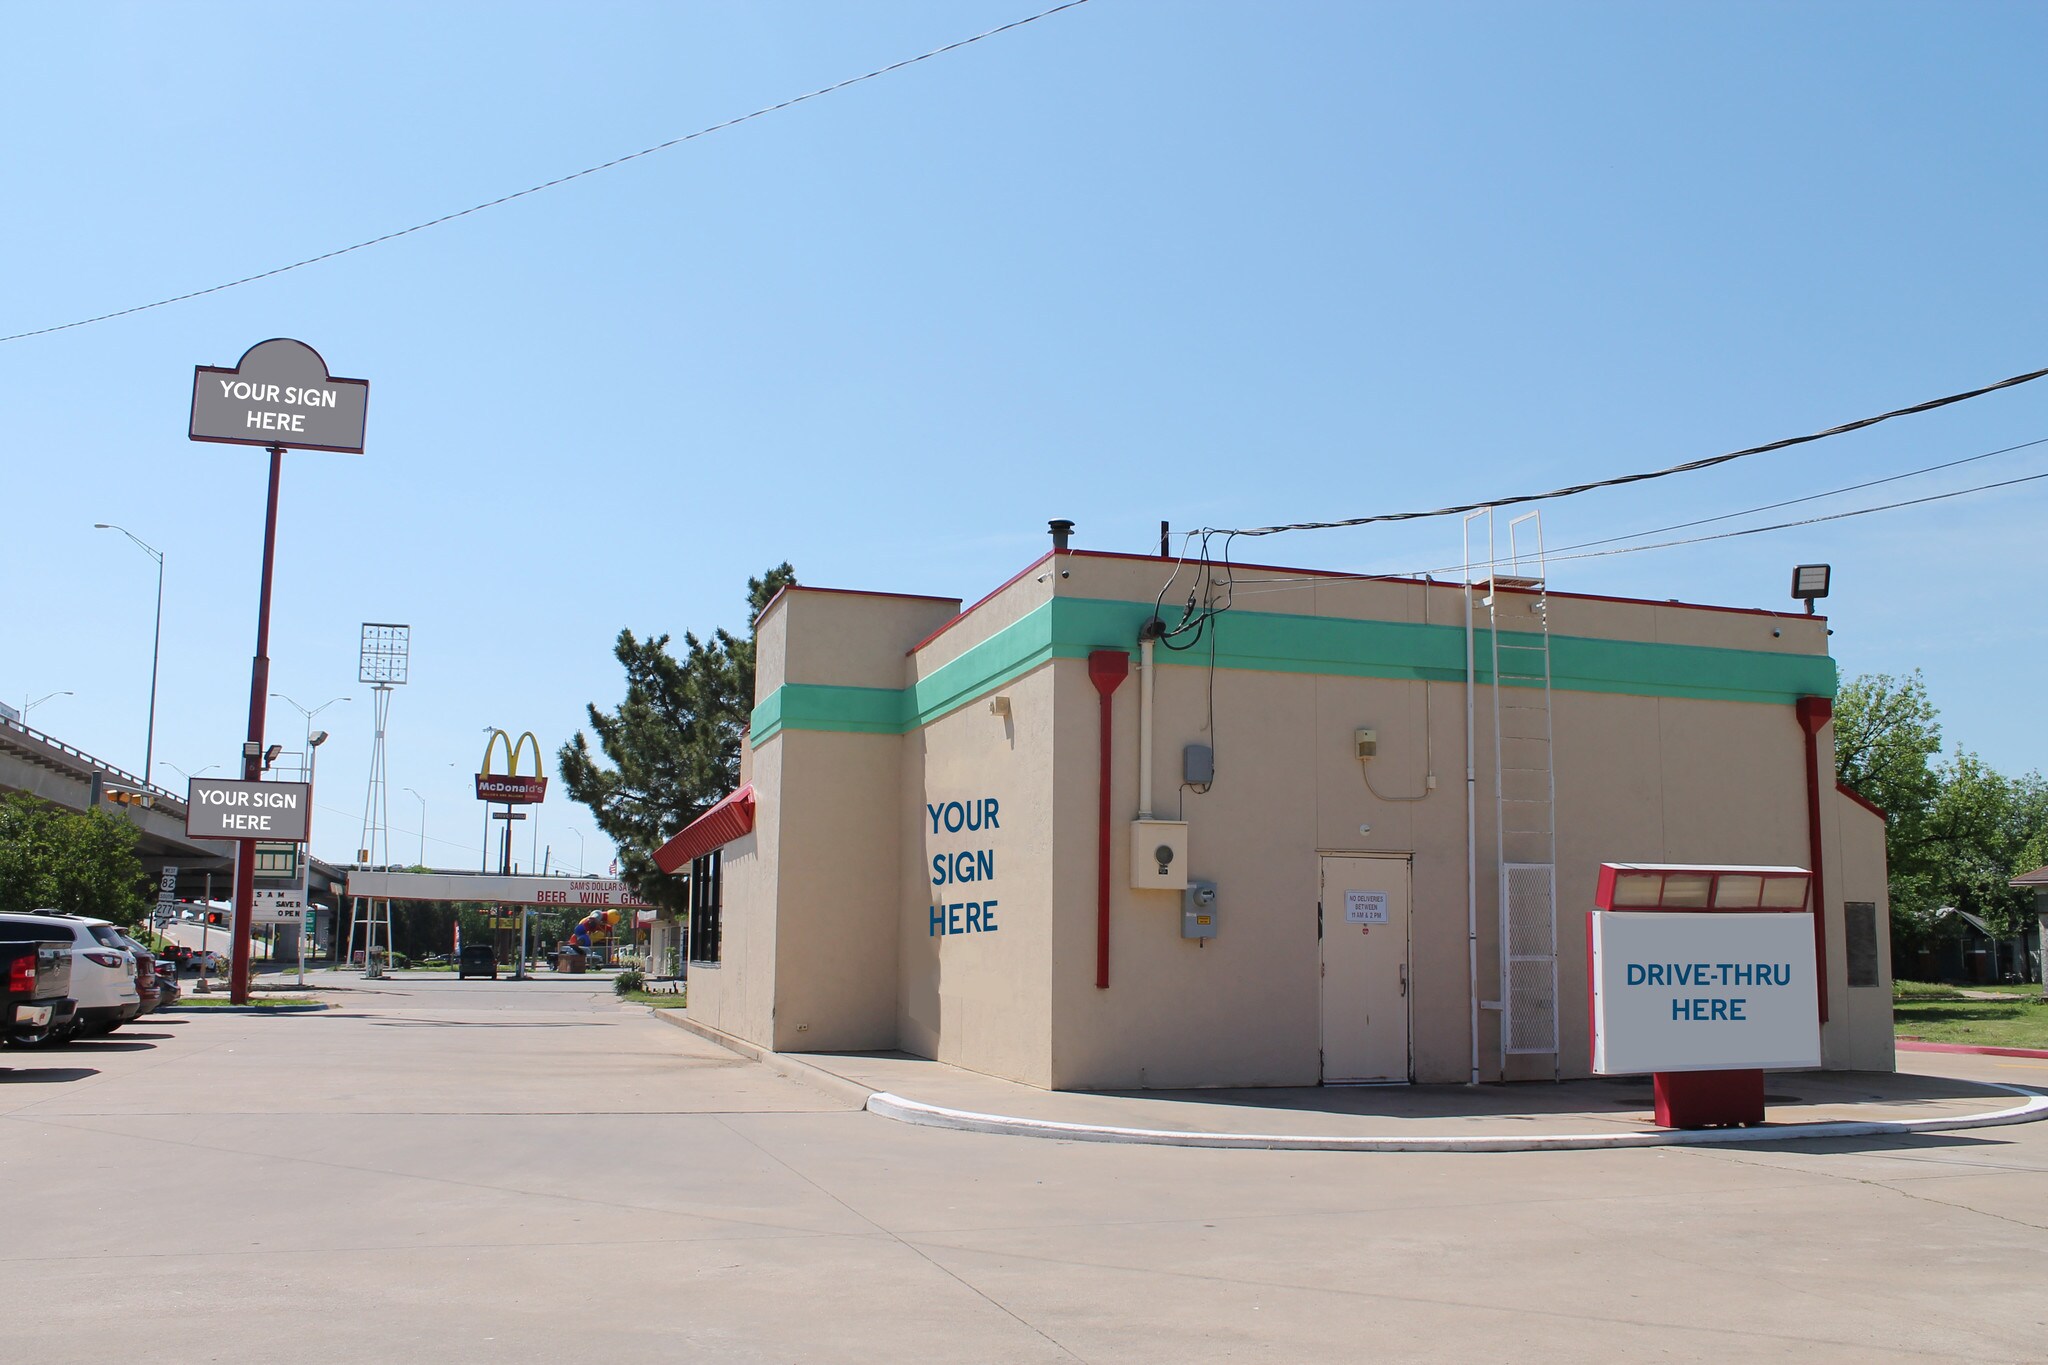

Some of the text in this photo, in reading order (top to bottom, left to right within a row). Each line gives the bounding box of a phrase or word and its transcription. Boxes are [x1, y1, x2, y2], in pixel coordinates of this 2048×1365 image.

[220, 380, 337, 408] YOUR SIGN
[246, 410, 306, 433] HERE
[479, 782, 544, 793] McDonald's
[198, 789, 297, 809] YOUR SIGN
[222, 813, 272, 830] HERE
[927, 798, 1000, 834] YOUR
[932, 849, 994, 886] SIGN
[162, 878, 175, 889] 82
[570, 881, 590, 891] SAM'S
[592, 882, 617, 892] DOLLAR
[537, 890, 567, 903] BEER
[579, 892, 610, 904] WINE
[157, 904, 173, 915] 277
[929, 900, 998, 937] HERE
[1627, 963, 1791, 986] DRIVE-THRU
[1672, 999, 1747, 1021] HERE
